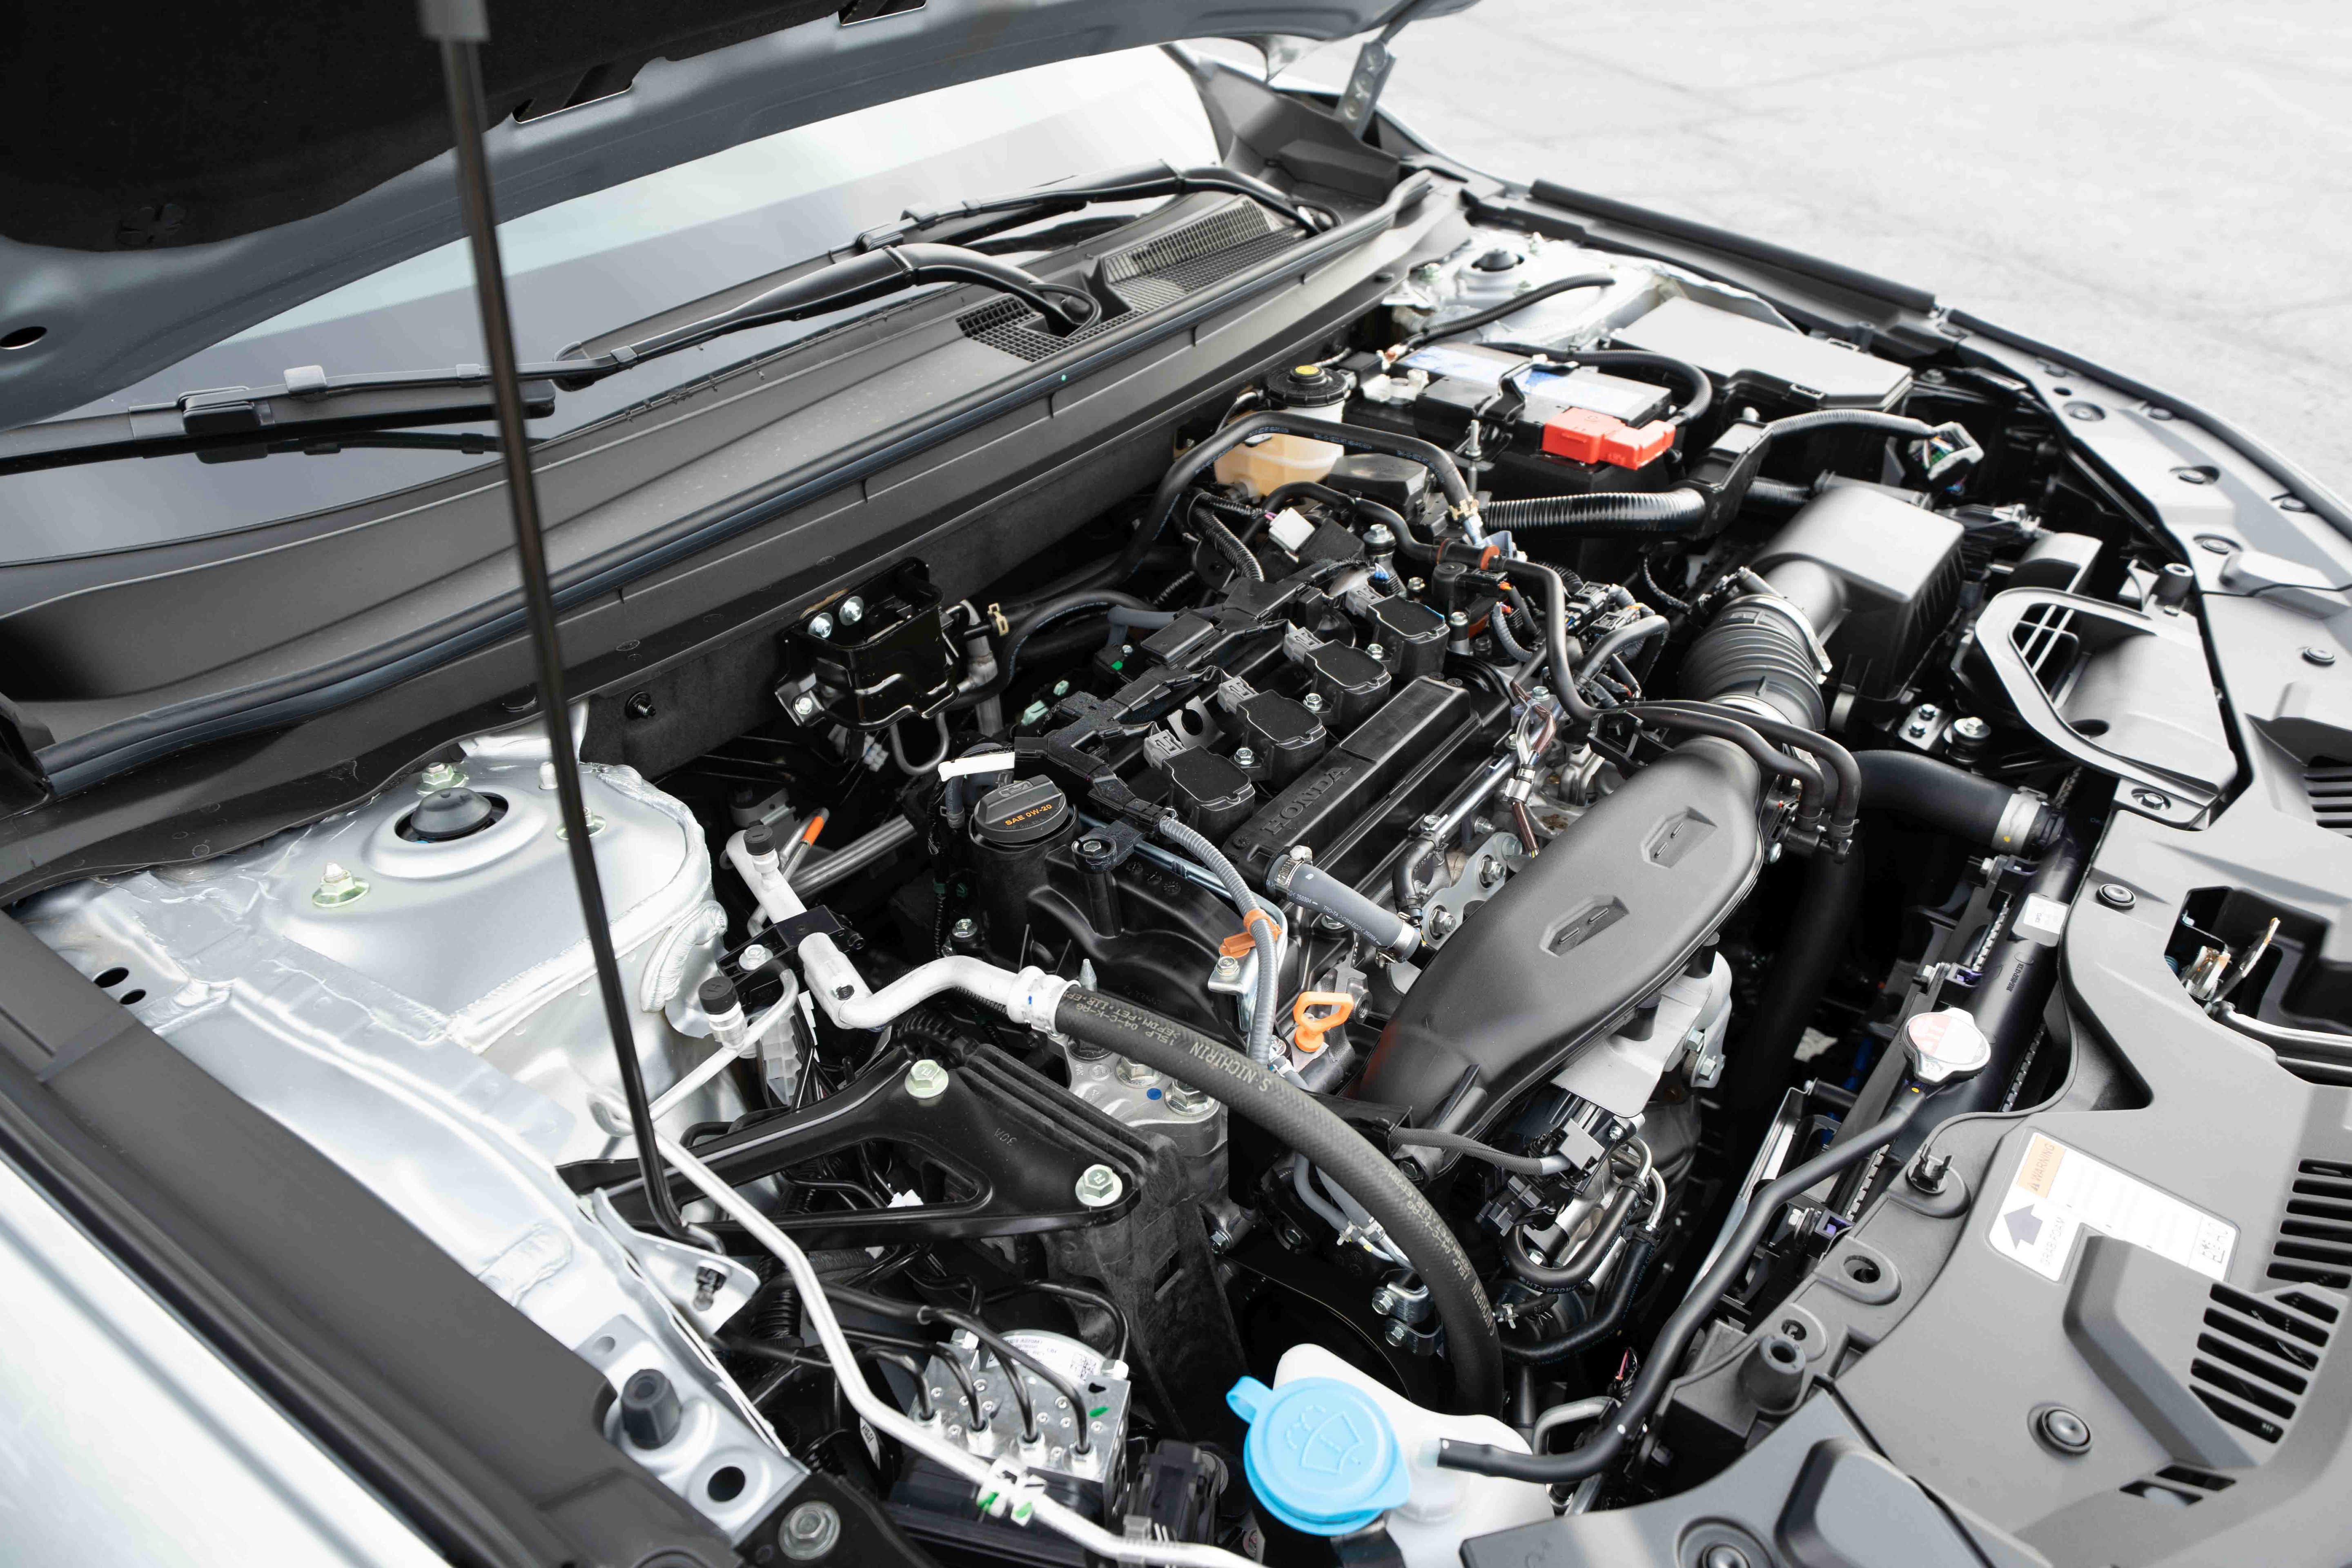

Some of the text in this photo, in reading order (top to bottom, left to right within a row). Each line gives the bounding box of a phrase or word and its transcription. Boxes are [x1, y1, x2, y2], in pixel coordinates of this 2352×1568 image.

[1005, 804, 1052, 825] SAE 0W-20
[1260, 767, 1352, 835] HONDA
[1189, 1041, 1257, 1084] NICHIRIN
[2031, 1142, 2055, 1181] WARNING
